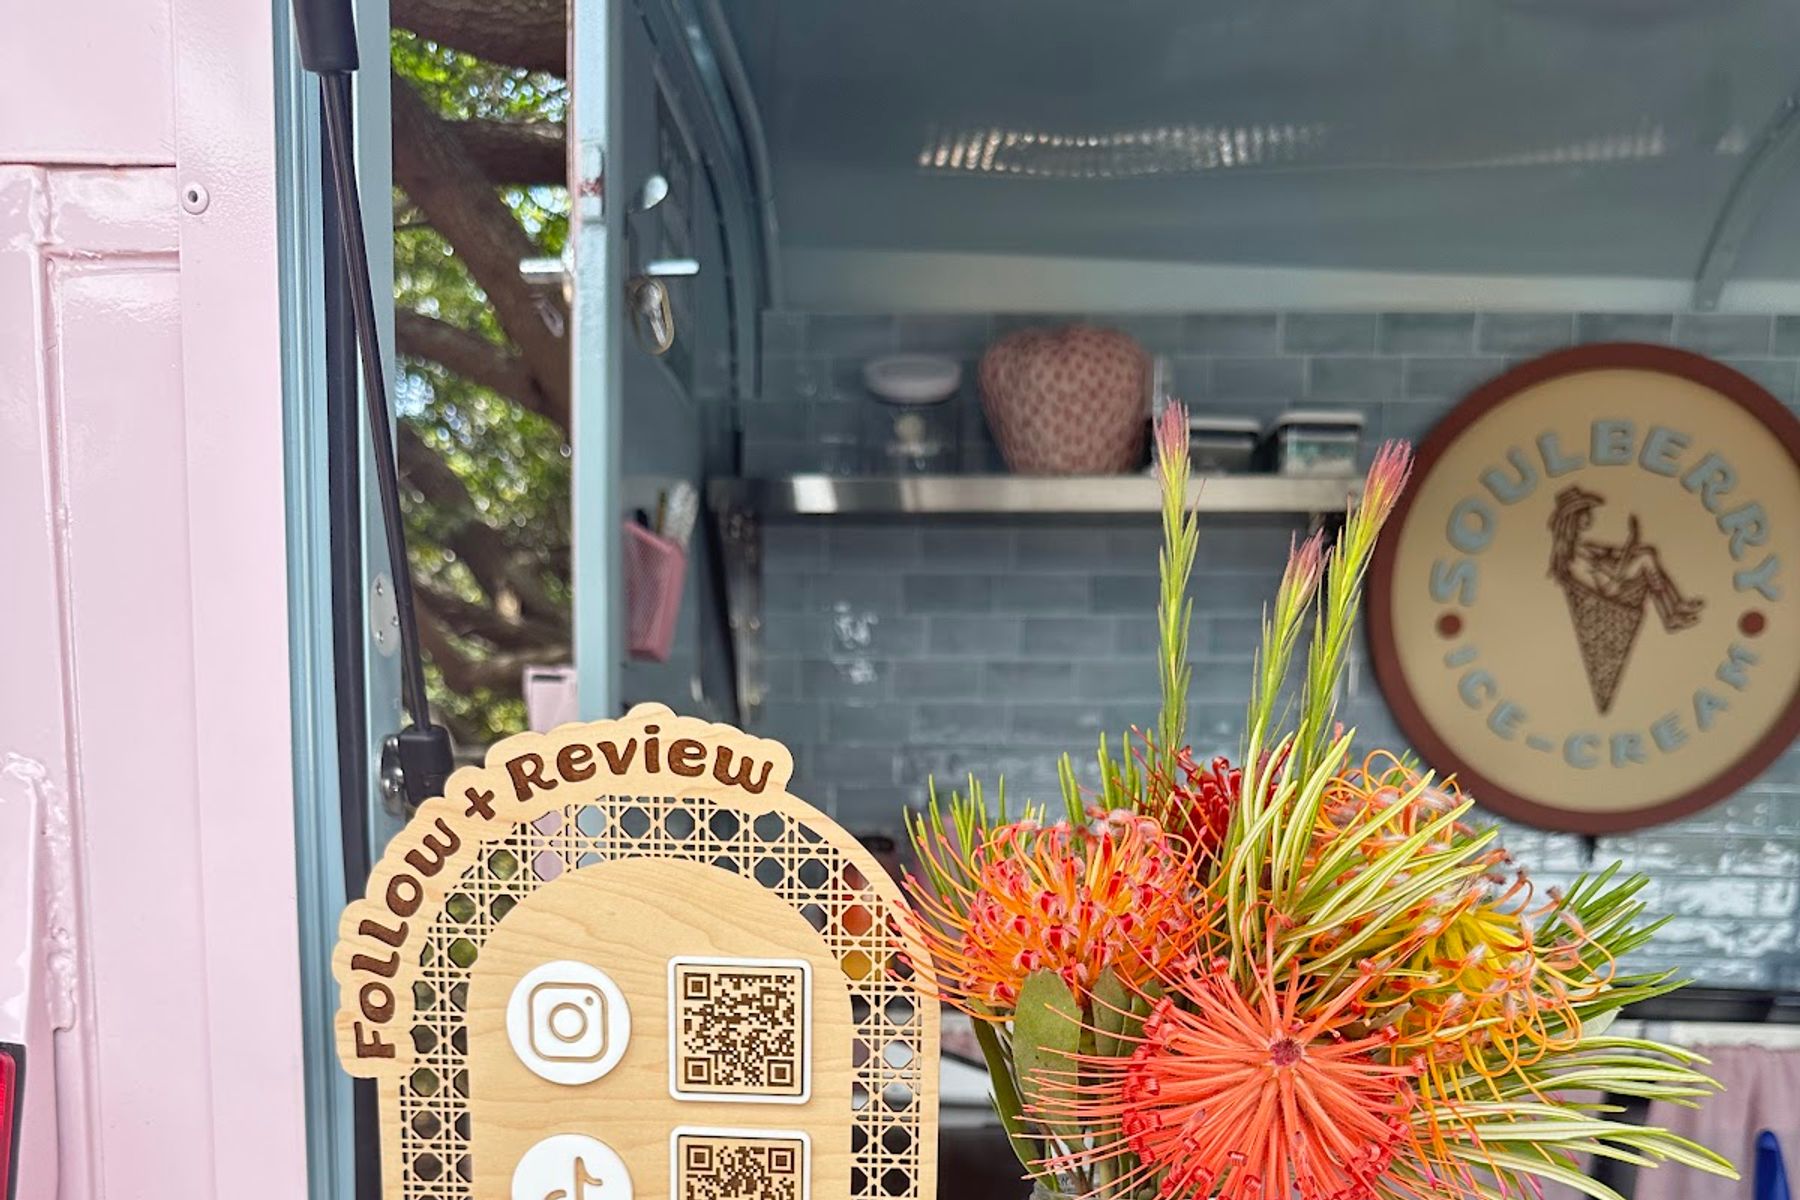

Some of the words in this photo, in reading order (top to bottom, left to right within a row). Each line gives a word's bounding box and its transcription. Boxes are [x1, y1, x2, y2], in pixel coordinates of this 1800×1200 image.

[1429, 418, 1781, 606] SOULBERRY
[1443, 643, 1759, 770] ICE-CREAM
[351, 817, 462, 1059] Follow
[464, 786, 497, 821] +
[505, 723, 774, 803] Review
